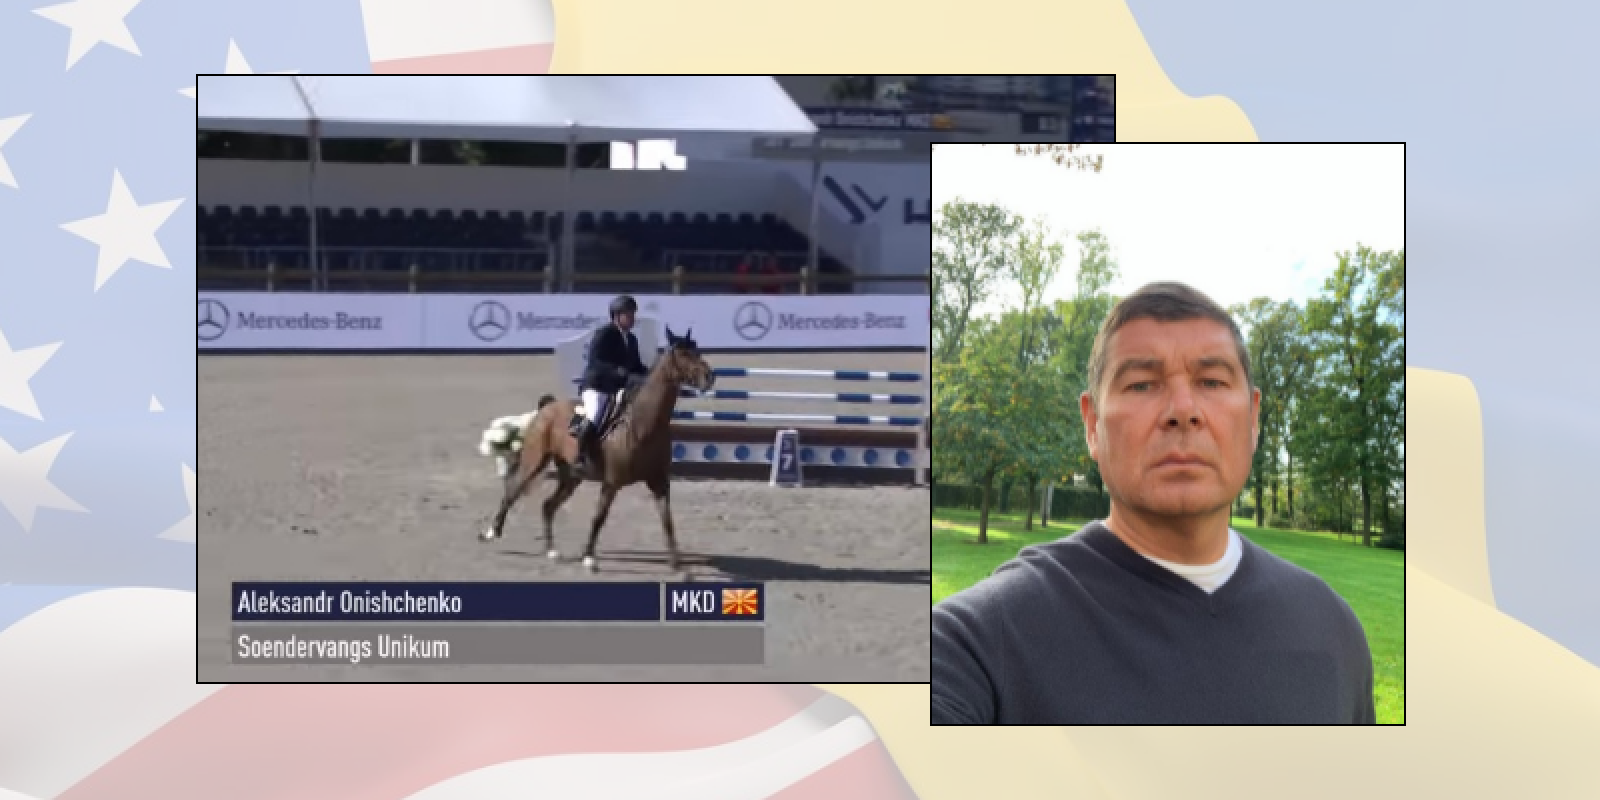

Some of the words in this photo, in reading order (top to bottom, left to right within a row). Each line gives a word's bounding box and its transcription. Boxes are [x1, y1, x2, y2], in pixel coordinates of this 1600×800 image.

[237, 310, 383, 330] Mercedes-Benz
[777, 312, 907, 330] Mercedes-Benz
[781, 453, 793, 471] 7
